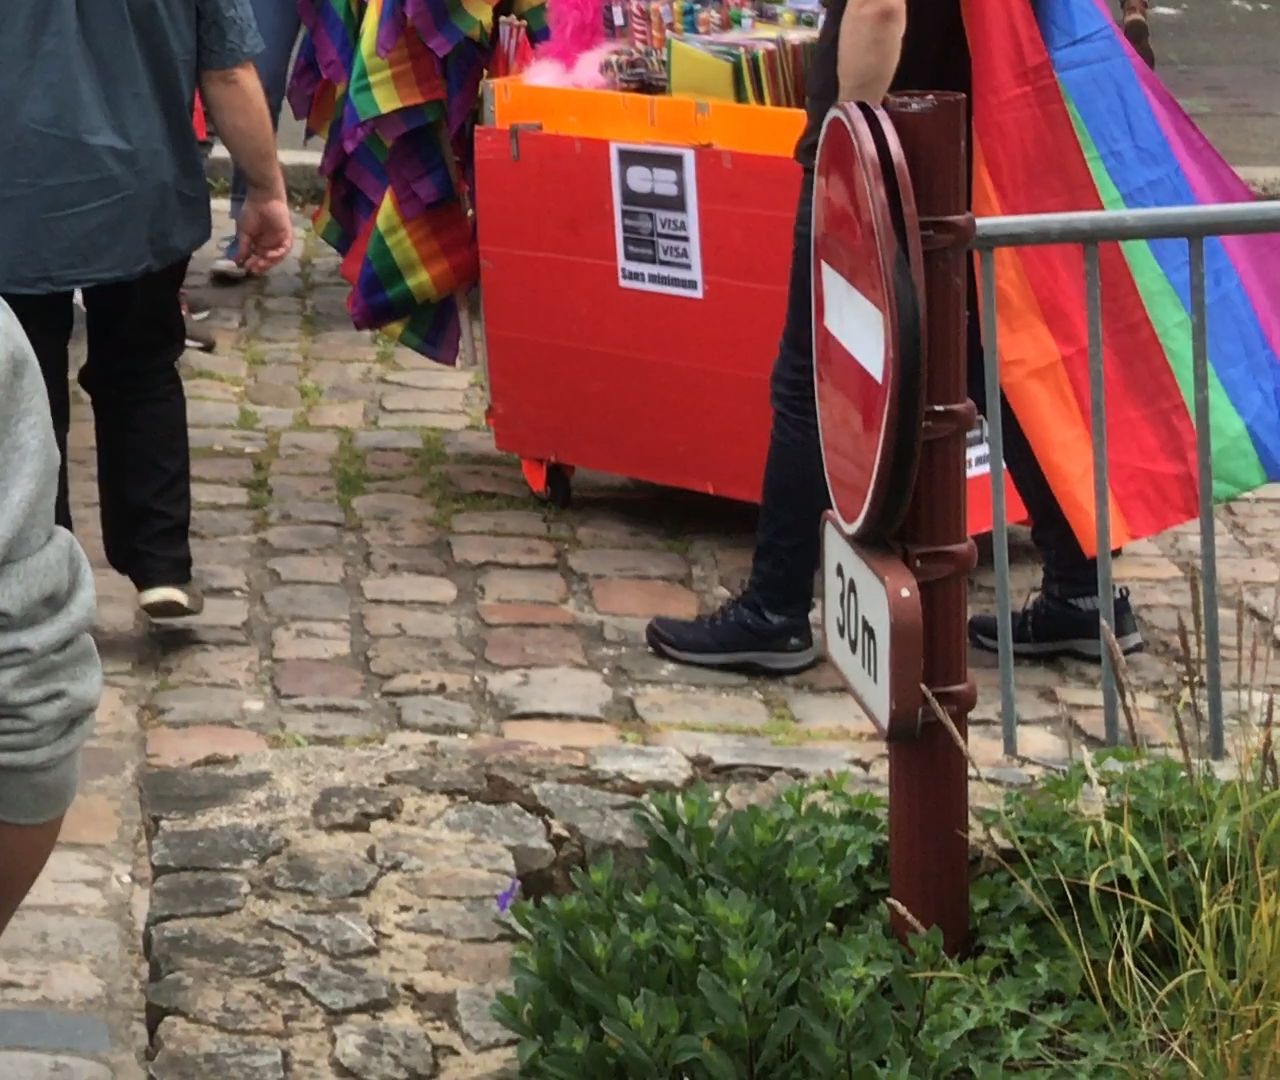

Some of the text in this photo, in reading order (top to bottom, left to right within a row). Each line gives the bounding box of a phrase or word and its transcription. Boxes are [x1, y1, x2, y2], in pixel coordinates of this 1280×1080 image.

[659, 217, 687, 232] VISA
[661, 245, 689, 260] VISA
[621, 266, 698, 291] Sans minimum
